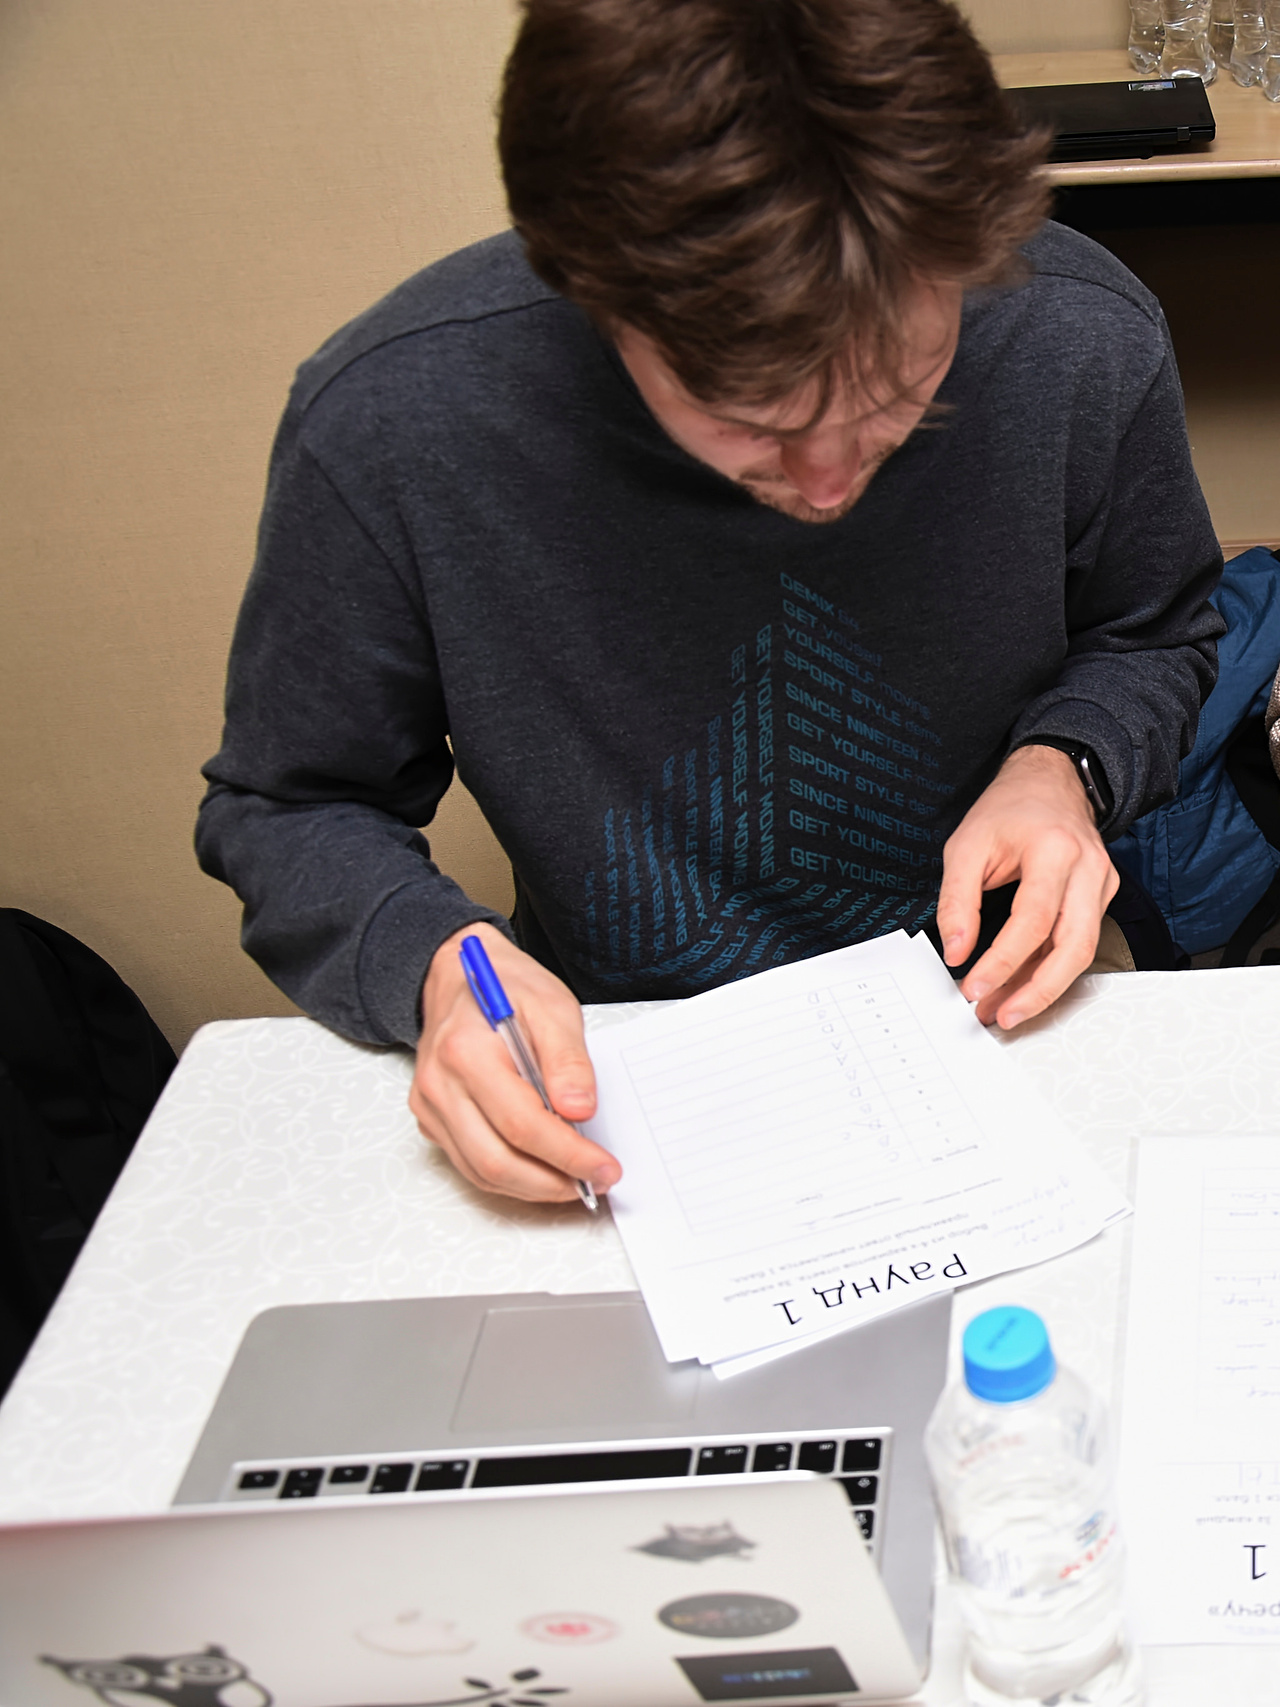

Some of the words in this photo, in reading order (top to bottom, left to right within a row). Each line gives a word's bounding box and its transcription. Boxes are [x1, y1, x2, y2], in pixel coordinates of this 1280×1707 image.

[781, 572, 834, 616] DEMIX
[783, 599, 818, 628] GET
[732, 644, 746, 687] GET
[757, 624, 771, 666] GET
[784, 623, 875, 683] YOURSELF
[784, 650, 847, 694] SPORT
[851, 688, 902, 727] STYLE
[732, 690, 748, 806] YOURSELF
[757, 668, 774, 788] YOURSELF
[786, 682, 842, 724] SINCE
[847, 714, 918, 760] NINETEEN
[787, 713, 825, 741] GET
[831, 733, 912, 779] YOURSELF
[789, 745, 850, 784] SPORT
[855, 776, 904, 807] STYLE
[685, 806, 698, 853] STYLE
[709, 775, 723, 867] NINETEEN
[759, 791, 775, 880] MOVING
[790, 778, 848, 814] SINCE
[854, 804, 931, 843] NINETEEN
[790, 809, 831, 836] GET
[837, 825, 928, 868] YOURSELF
[733, 811, 749, 886] MOVING
[791, 846, 831, 873] GET
[837, 858, 925, 893] YOURSELF
[685, 854, 708, 927] DEMIX
[823, 892, 877, 932] DEMIX
[812, 1253, 968, 1309] Раунд
[773, 1299, 803, 1327] 1
[1196, 1515, 1253, 1526] каждый
[1242, 1544, 1268, 1580] 1
